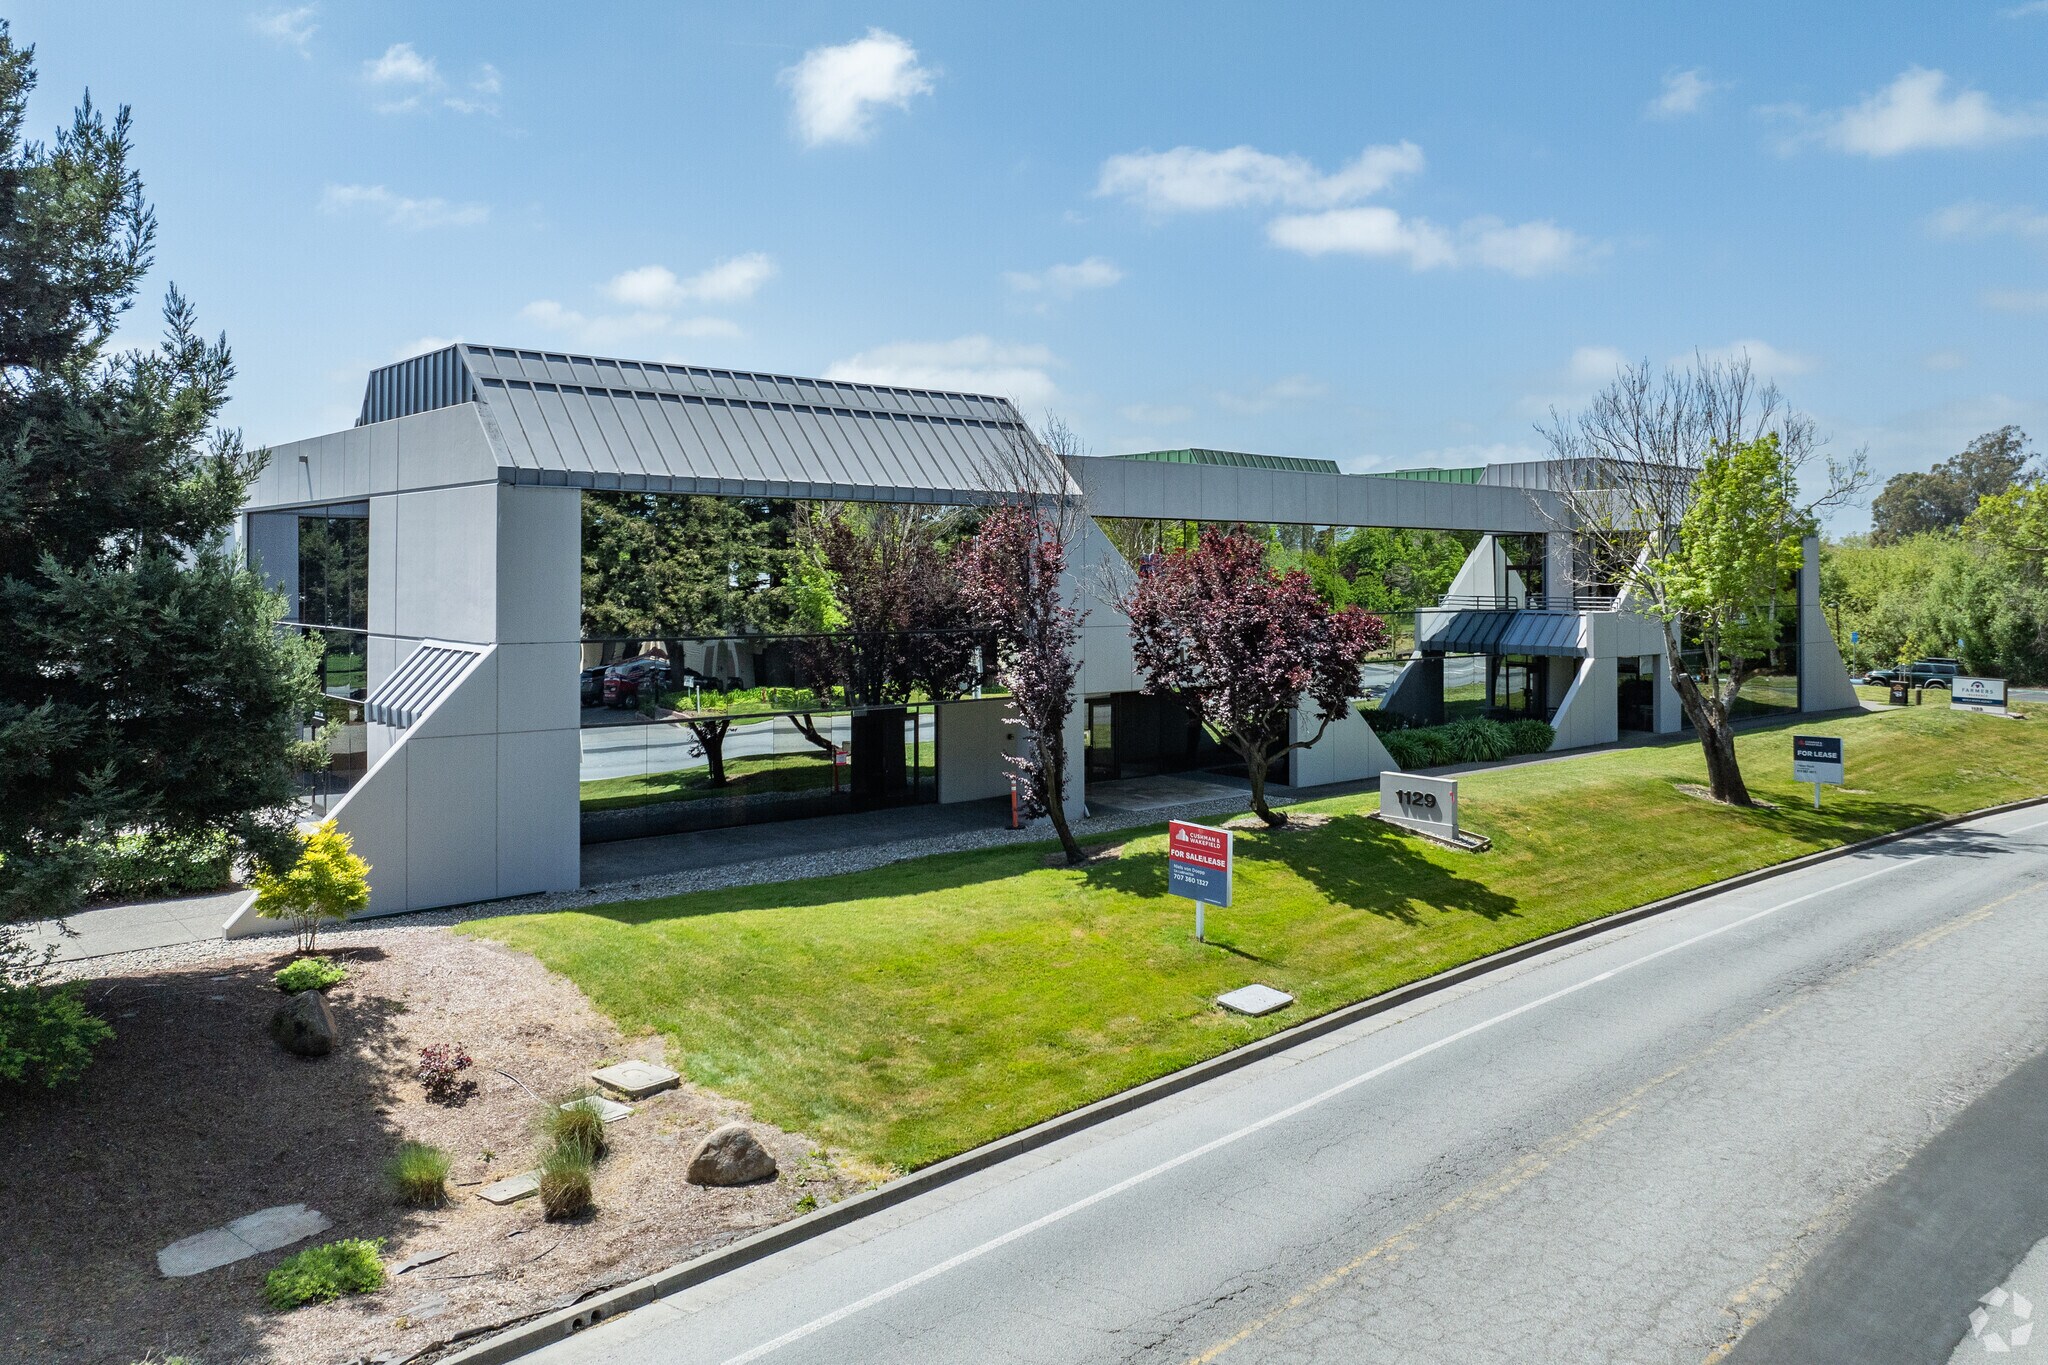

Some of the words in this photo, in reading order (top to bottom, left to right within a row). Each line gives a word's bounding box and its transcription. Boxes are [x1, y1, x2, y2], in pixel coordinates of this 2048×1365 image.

[1961, 687, 1994, 695] FARMERS
[1813, 751, 1838, 759] LEASE
[1395, 789, 1437, 809] 1129
[1189, 832, 1216, 844] CUSHMAN
[1189, 837, 1221, 849] WAKEFIELD
[1170, 848, 1185, 859] FOR
[1185, 852, 1226, 867] SALE/LEASE
[1173, 873, 1184, 881] 707
